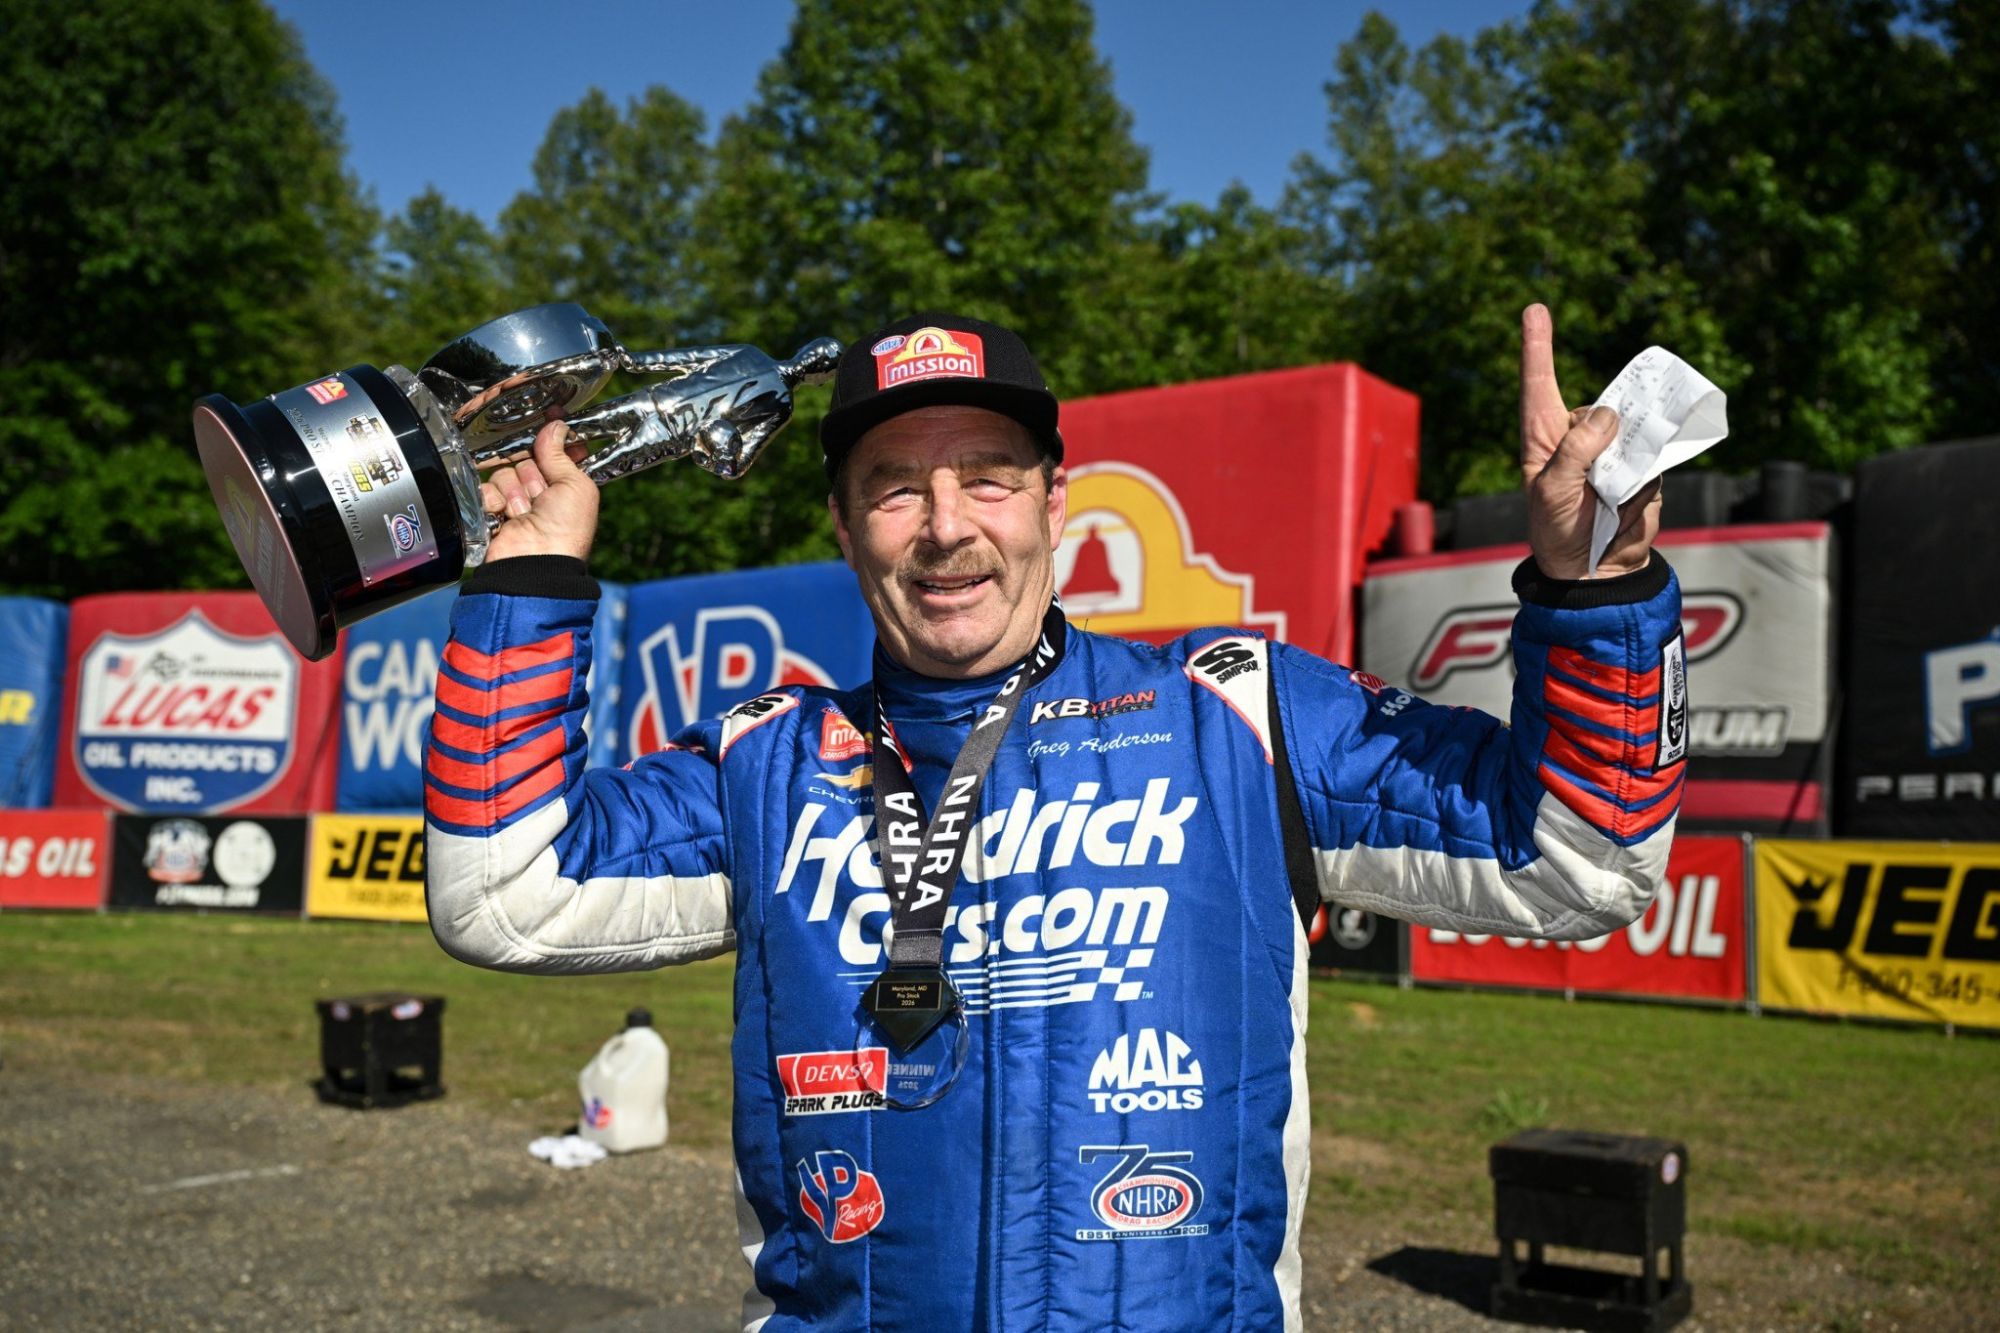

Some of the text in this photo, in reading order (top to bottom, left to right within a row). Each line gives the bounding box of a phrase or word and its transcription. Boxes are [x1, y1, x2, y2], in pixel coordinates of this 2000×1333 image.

[890, 357, 973, 381] mission
[298, 421, 318, 442] PRO
[330, 477, 364, 543] CHAMPION
[102, 685, 275, 729] LUCAS
[1029, 698, 1090, 725] KB
[84, 743, 276, 773] OIL PRODUCTS
[1027, 731, 1174, 764] Greg Anderson
[145, 776, 203, 803] INC.
[1856, 773, 2000, 803] PER
[36, 836, 97, 878] OIL
[775, 777, 1198, 924] Hedrick
[884, 791, 922, 900] HRA
[909, 774, 977, 912] NHRA
[1626, 874, 1728, 958] OIL
[1142, 991, 1154, 1000] TM
[1088, 1028, 1204, 1090] MAC
[786, 1096, 825, 1113] SPARK
[1087, 1088, 1204, 1114] TOOLS
[796, 1149, 859, 1243] VP
[1079, 1144, 1205, 1230] 75
[1118, 1186, 1178, 1215] NHRA
[836, 1200, 884, 1231] Racing
[1118, 1216, 1141, 1225] DRAG
[1078, 1231, 1111, 1239] 1951
